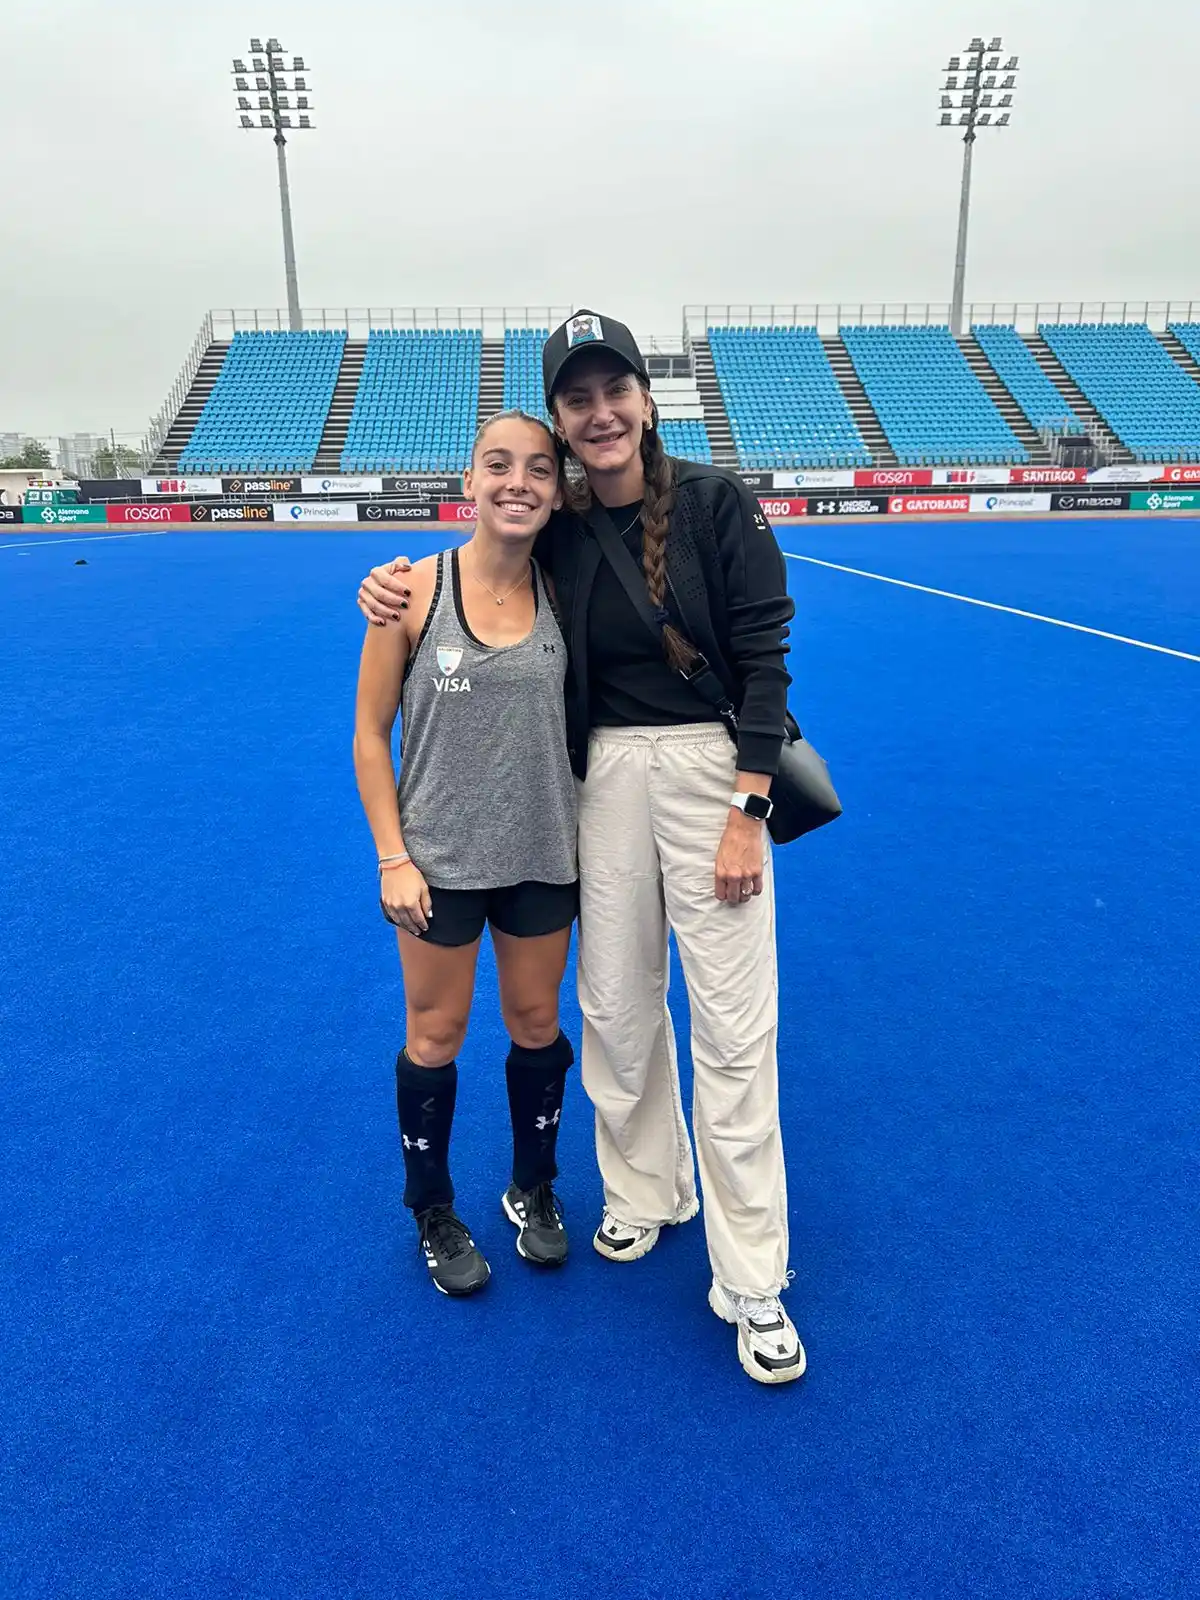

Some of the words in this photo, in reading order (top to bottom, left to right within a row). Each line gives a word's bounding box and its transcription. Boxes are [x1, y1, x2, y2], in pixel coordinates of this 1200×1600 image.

[872, 471, 913, 484] rosen
[1022, 470, 1076, 482] SANTIAGO
[244, 480, 291, 492] passline
[906, 499, 968, 511] GATORADE
[125, 507, 171, 520] rosen
[211, 506, 268, 521] passline
[303, 507, 339, 517] Principal
[431, 677, 472, 692] VISA
